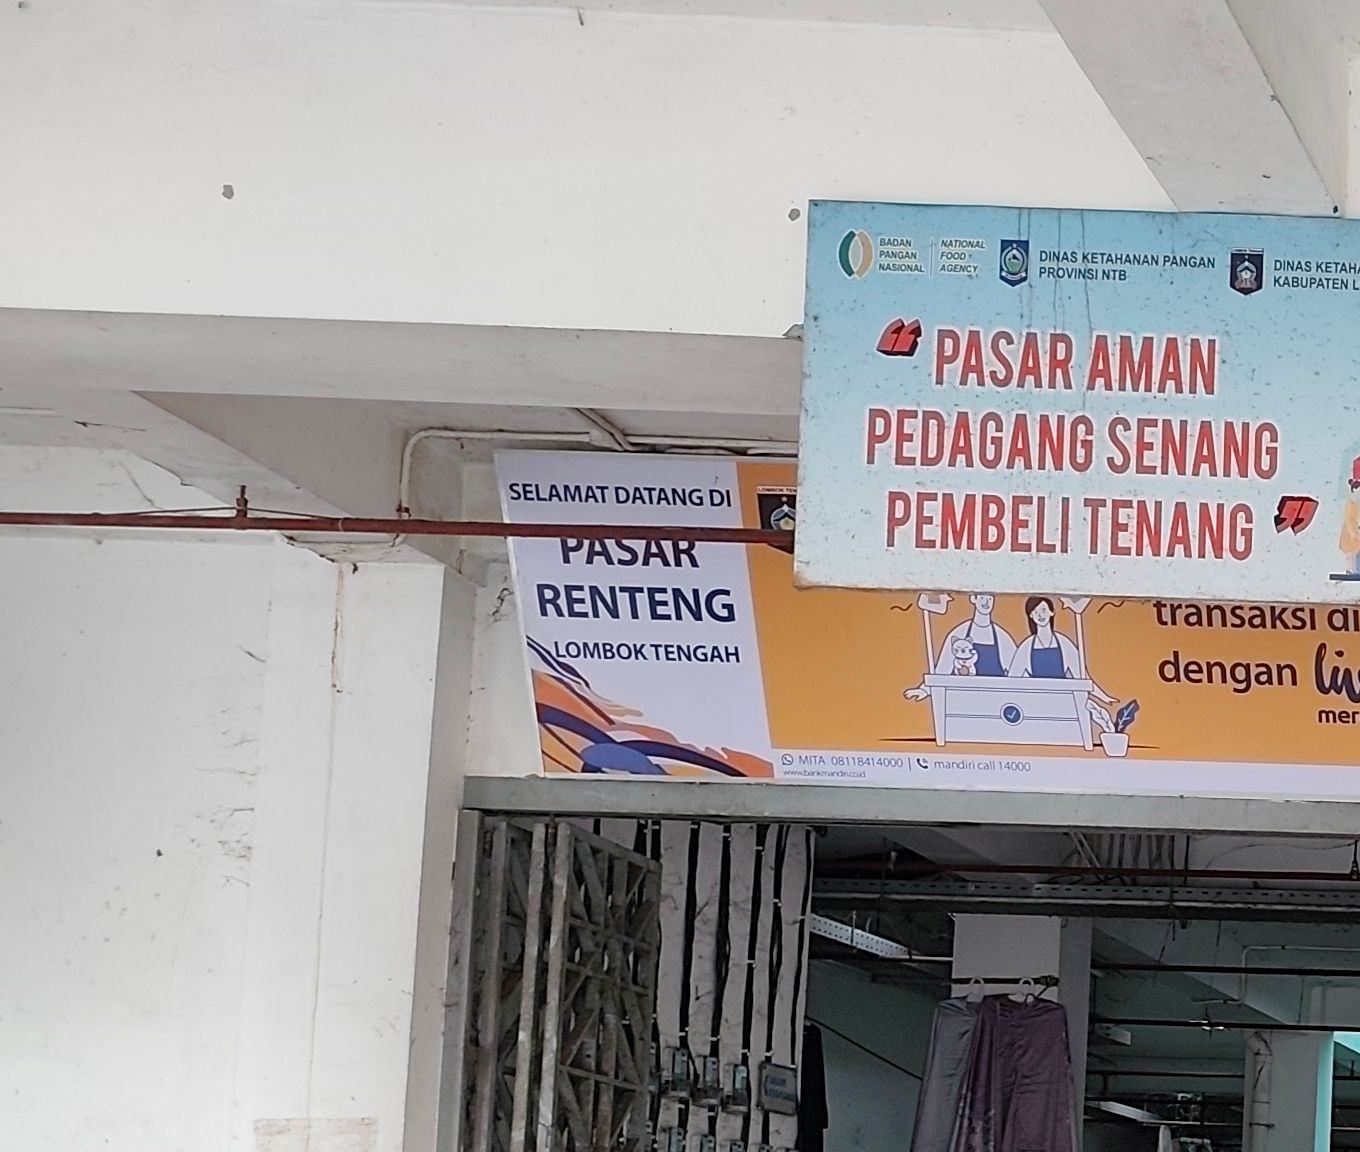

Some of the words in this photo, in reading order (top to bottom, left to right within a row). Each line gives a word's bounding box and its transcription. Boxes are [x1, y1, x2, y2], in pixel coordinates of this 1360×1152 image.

[879, 238, 912, 248] BADAN
[940, 239, 986, 249] NATIONAL
[878, 250, 917, 260] PANGAN
[940, 251, 966, 261] FOOD
[1039, 250, 1078, 263] DINAS
[1082, 252, 1159, 267] KETAHANAN
[1162, 254, 1216, 269] PANGAN
[878, 262, 925, 273] NASIONAL
[939, 264, 979, 274] AGENCY
[1039, 267, 1099, 280] PROVINSI
[1102, 269, 1127, 281] NTB
[1273, 259, 1312, 274] DINAS
[1273, 275, 1349, 290] KABUPATEN
[935, 328, 1073, 391] PASAR
[1086, 334, 1217, 396] AMAN
[866, 407, 1094, 474] PEDAGANG
[1107, 415, 1279, 480] SENANG
[509, 482, 609, 504] SELAMAT
[614, 485, 704, 507] DATANG
[709, 488, 732, 508] DI
[886, 490, 1070, 555] PEMBELI
[1083, 497, 1254, 562] TENANG
[560, 538, 699, 568] PASAR
[536, 583, 736, 623] RENTENG
[1153, 600, 1316, 632] transaksi
[554, 640, 648, 661] LOMBOK
[650, 643, 741, 664] TENGAH
[1158, 650, 1297, 693] dengan
[798, 755, 825, 766] MITA
[831, 757, 903, 768] 08118414000
[934, 759, 975, 769] mandiri
[977, 760, 995, 770] call
[999, 760, 1031, 772] 14000
